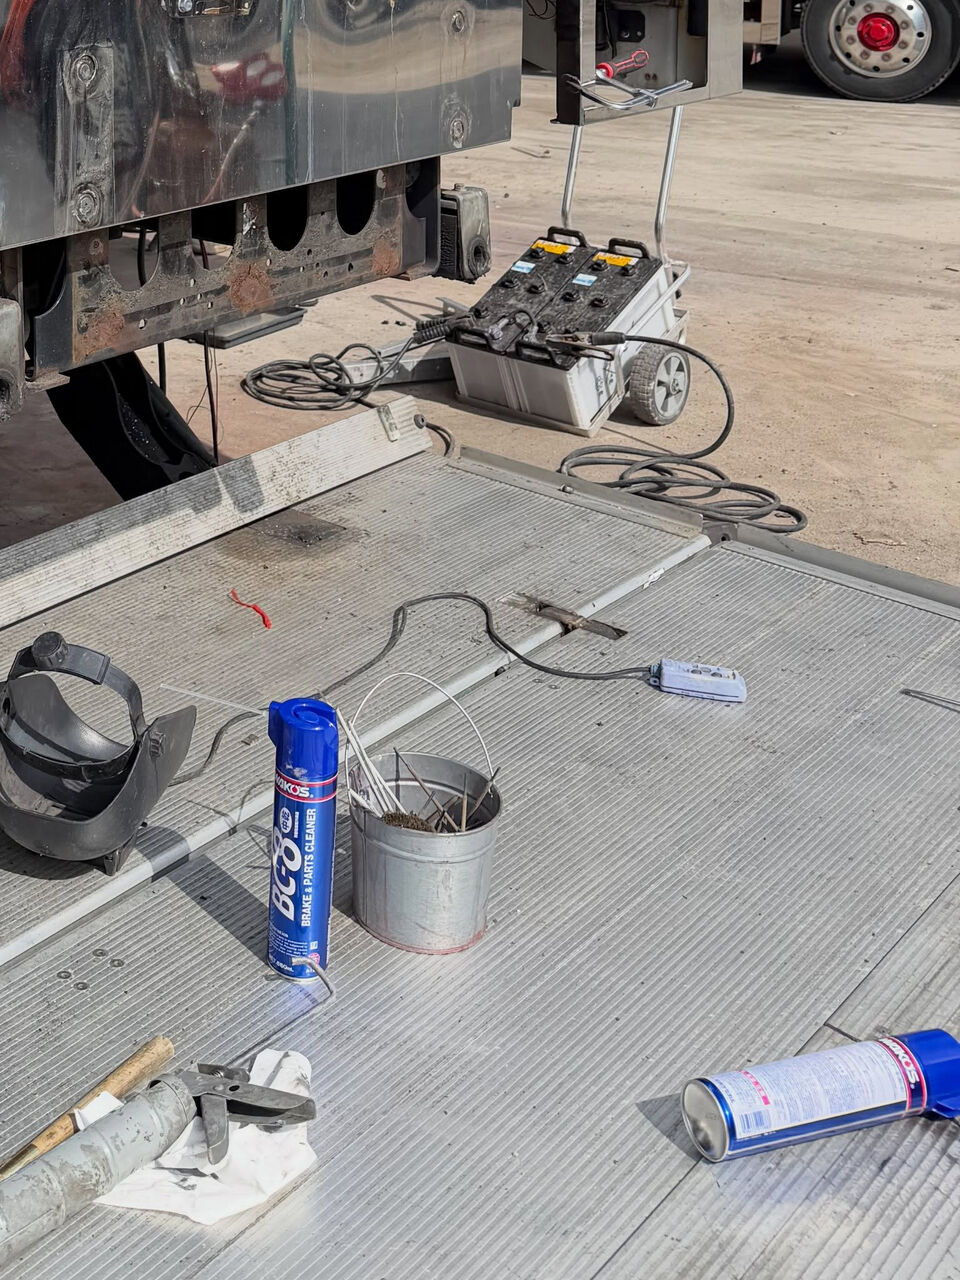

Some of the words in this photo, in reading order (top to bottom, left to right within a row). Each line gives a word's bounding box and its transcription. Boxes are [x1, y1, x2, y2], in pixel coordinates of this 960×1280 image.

[304, 808, 317, 852] CLEANER
[272, 826, 302, 921] BC-8
[303, 853, 315, 886] PARTS
[301, 894, 312, 927] BRAKE
